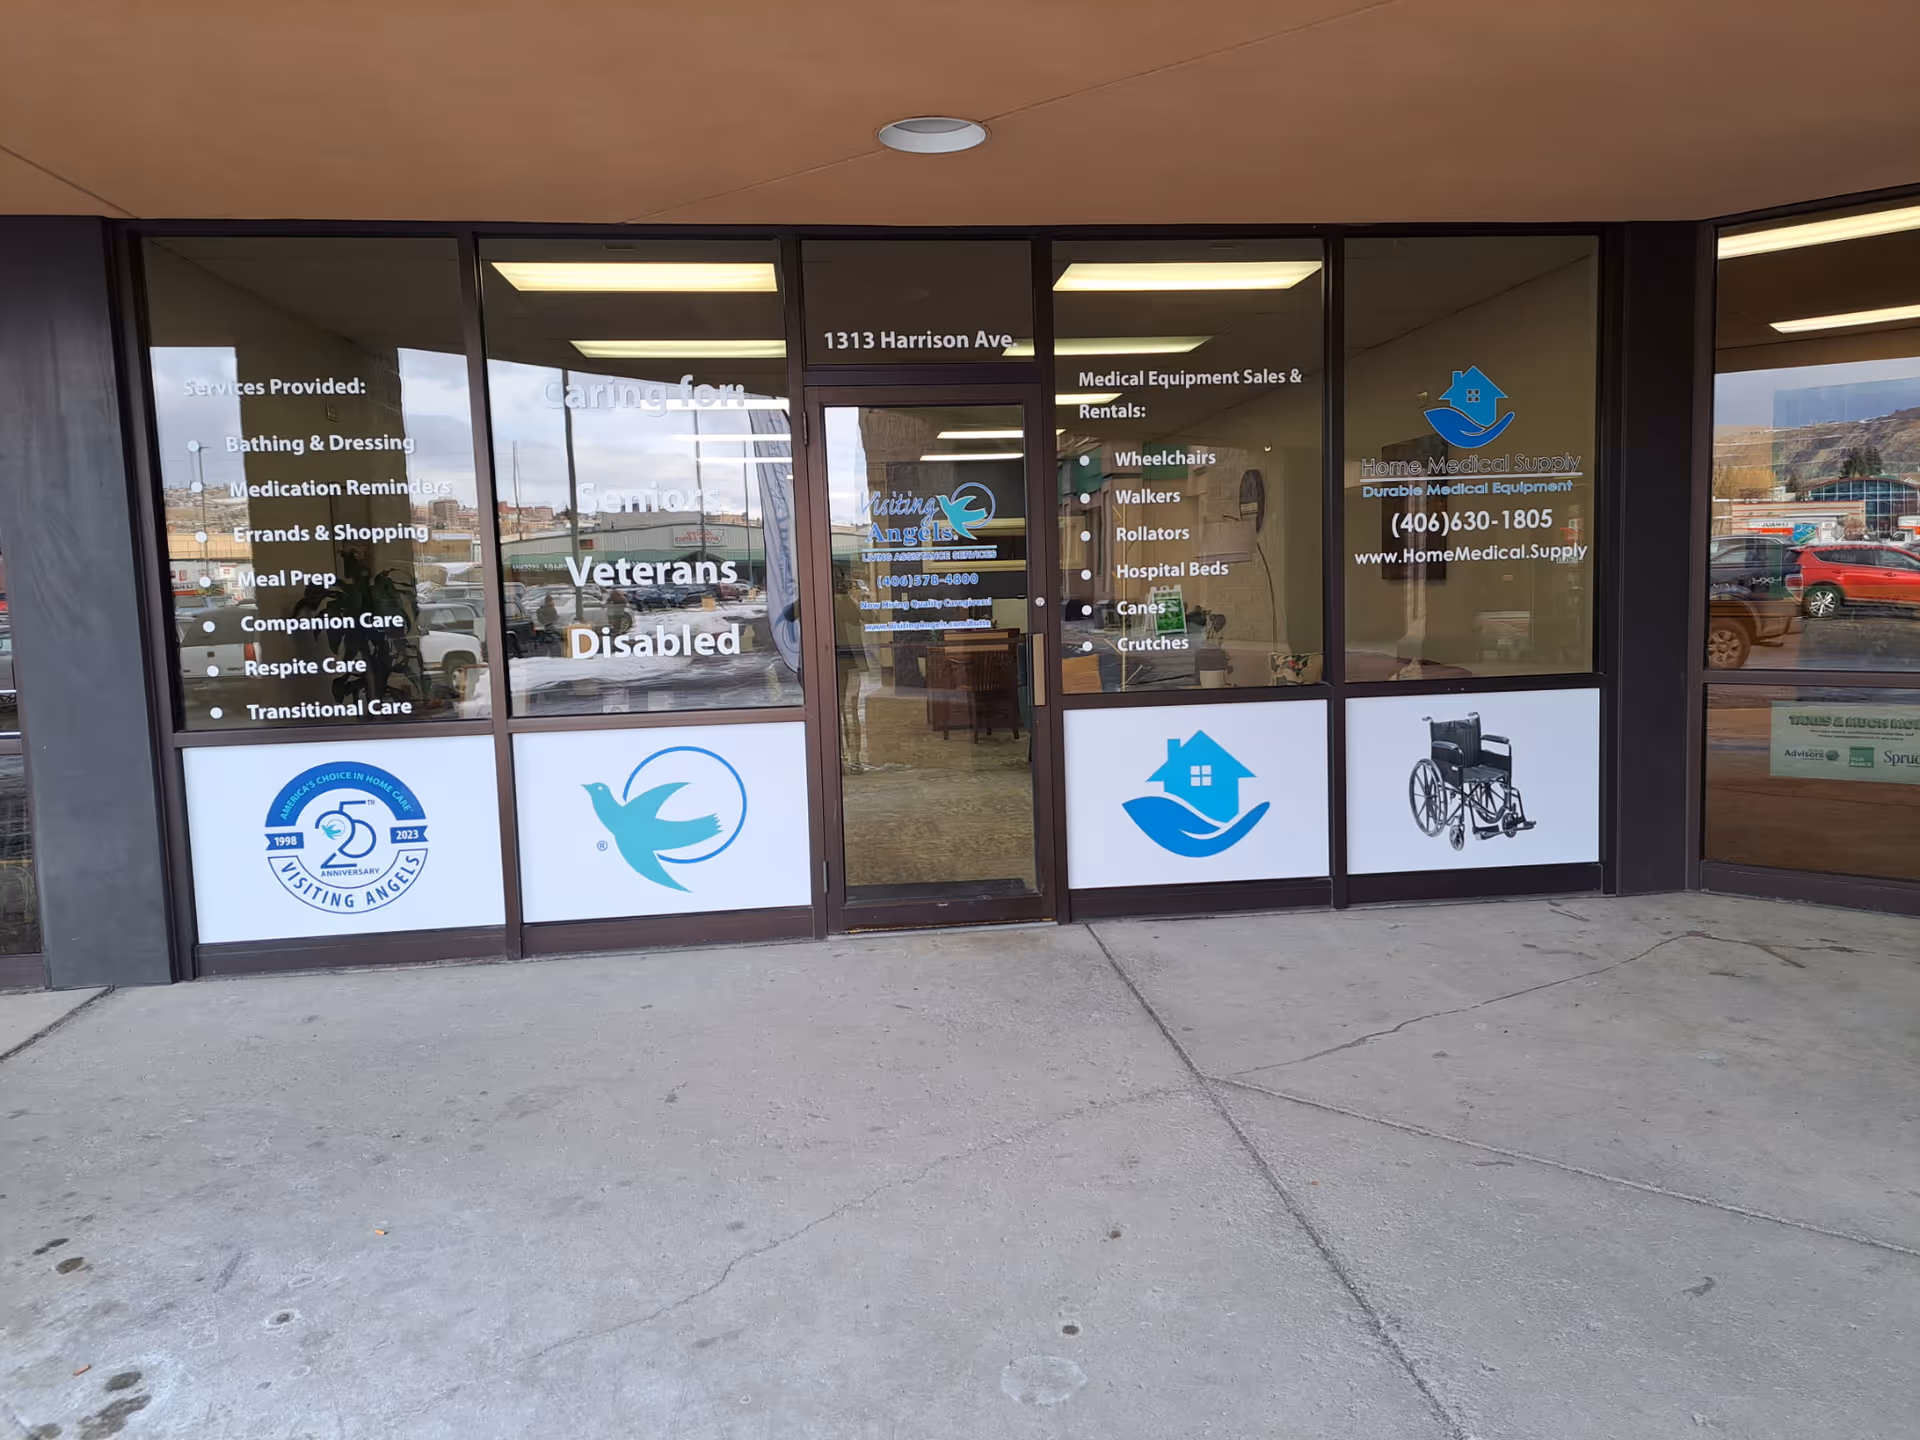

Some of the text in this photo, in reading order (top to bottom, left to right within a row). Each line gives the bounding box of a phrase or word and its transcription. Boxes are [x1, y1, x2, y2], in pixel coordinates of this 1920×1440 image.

[824, 330, 1018, 350] 1313 Harrison Ave.
[184, 377, 366, 397] Services Provided:
[1079, 368, 1303, 389] Medical Equipment Sales &
[543, 374, 745, 417] Caring for:
[1079, 403, 1146, 419] Rentals:
[225, 433, 416, 455] Bathing & Dressing
[1115, 450, 1216, 467] Wheelchairs
[1361, 452, 1581, 476] Home Medical Supply
[230, 478, 452, 499] Medication Reminders
[576, 481, 721, 514] Seniors
[1115, 488, 1181, 504] Walkers
[1362, 480, 1573, 498] Durable Medical Equipment
[860, 490, 940, 527] Visiting
[233, 523, 429, 544] Errands & Shopping
[1391, 509, 1553, 538] (406)630-1805
[1116, 526, 1190, 542] Rollators
[862, 550, 997, 562] LIVING ASSISTANCE SERVICES
[1354, 542, 1588, 565] www.HomeMedical.Supply
[238, 570, 337, 589] Meal Prep
[565, 556, 738, 587] Veterans
[877, 573, 979, 588] (406)578-4800
[1116, 561, 1229, 581] Hospital Beds
[860, 600, 880, 610] Now
[881, 600, 909, 610] Hiring
[910, 598, 942, 609] Quality
[1116, 601, 1166, 616] Canes
[241, 612, 404, 634] Companion Care
[571, 624, 741, 660] Disabled
[1117, 636, 1189, 652] Crutches
[245, 657, 367, 679] Respite Care
[247, 699, 412, 720] Transitional Care
[1784, 749, 1825, 759] Advisors
[280, 780, 316, 820] AMERICA'S
[316, 771, 352, 785] CHOICE
[353, 771, 364, 781] IN
[366, 775, 393, 793] HOME
[273, 836, 297, 846] 1998
[396, 830, 419, 840] 2023
[281, 855, 420, 908] VISITING ANGELS
[320, 867, 380, 878] ANNIVERSARY
